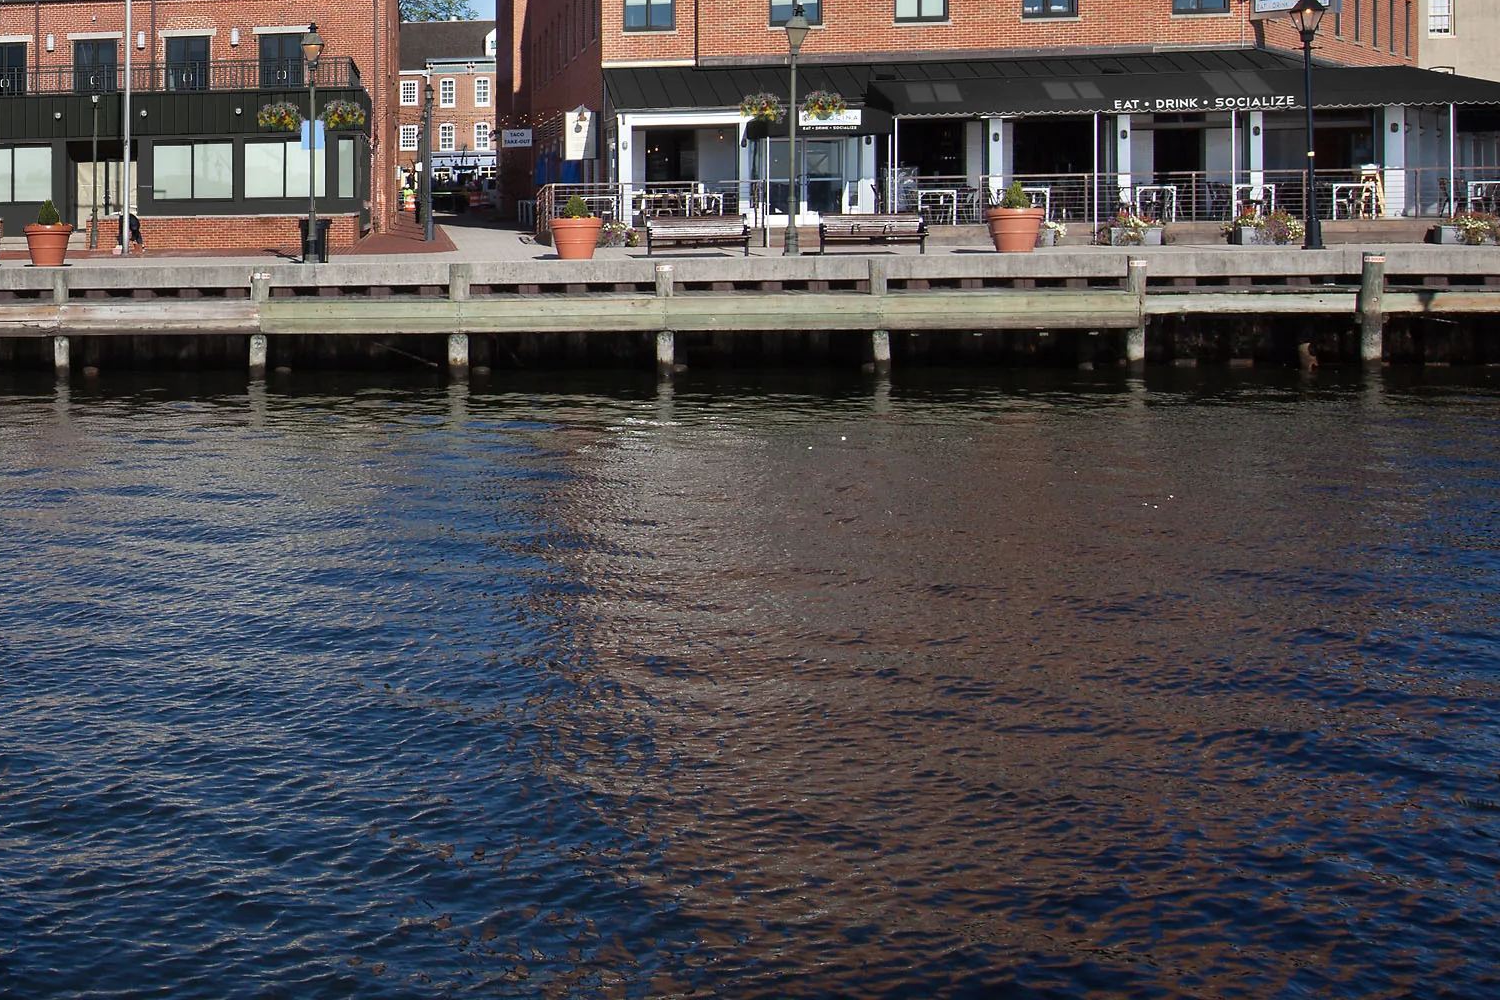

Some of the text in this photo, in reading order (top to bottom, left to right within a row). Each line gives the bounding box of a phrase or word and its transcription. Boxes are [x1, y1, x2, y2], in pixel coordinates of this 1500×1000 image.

[1114, 95, 1295, 109] EAT DRINK SOCIALIZE
